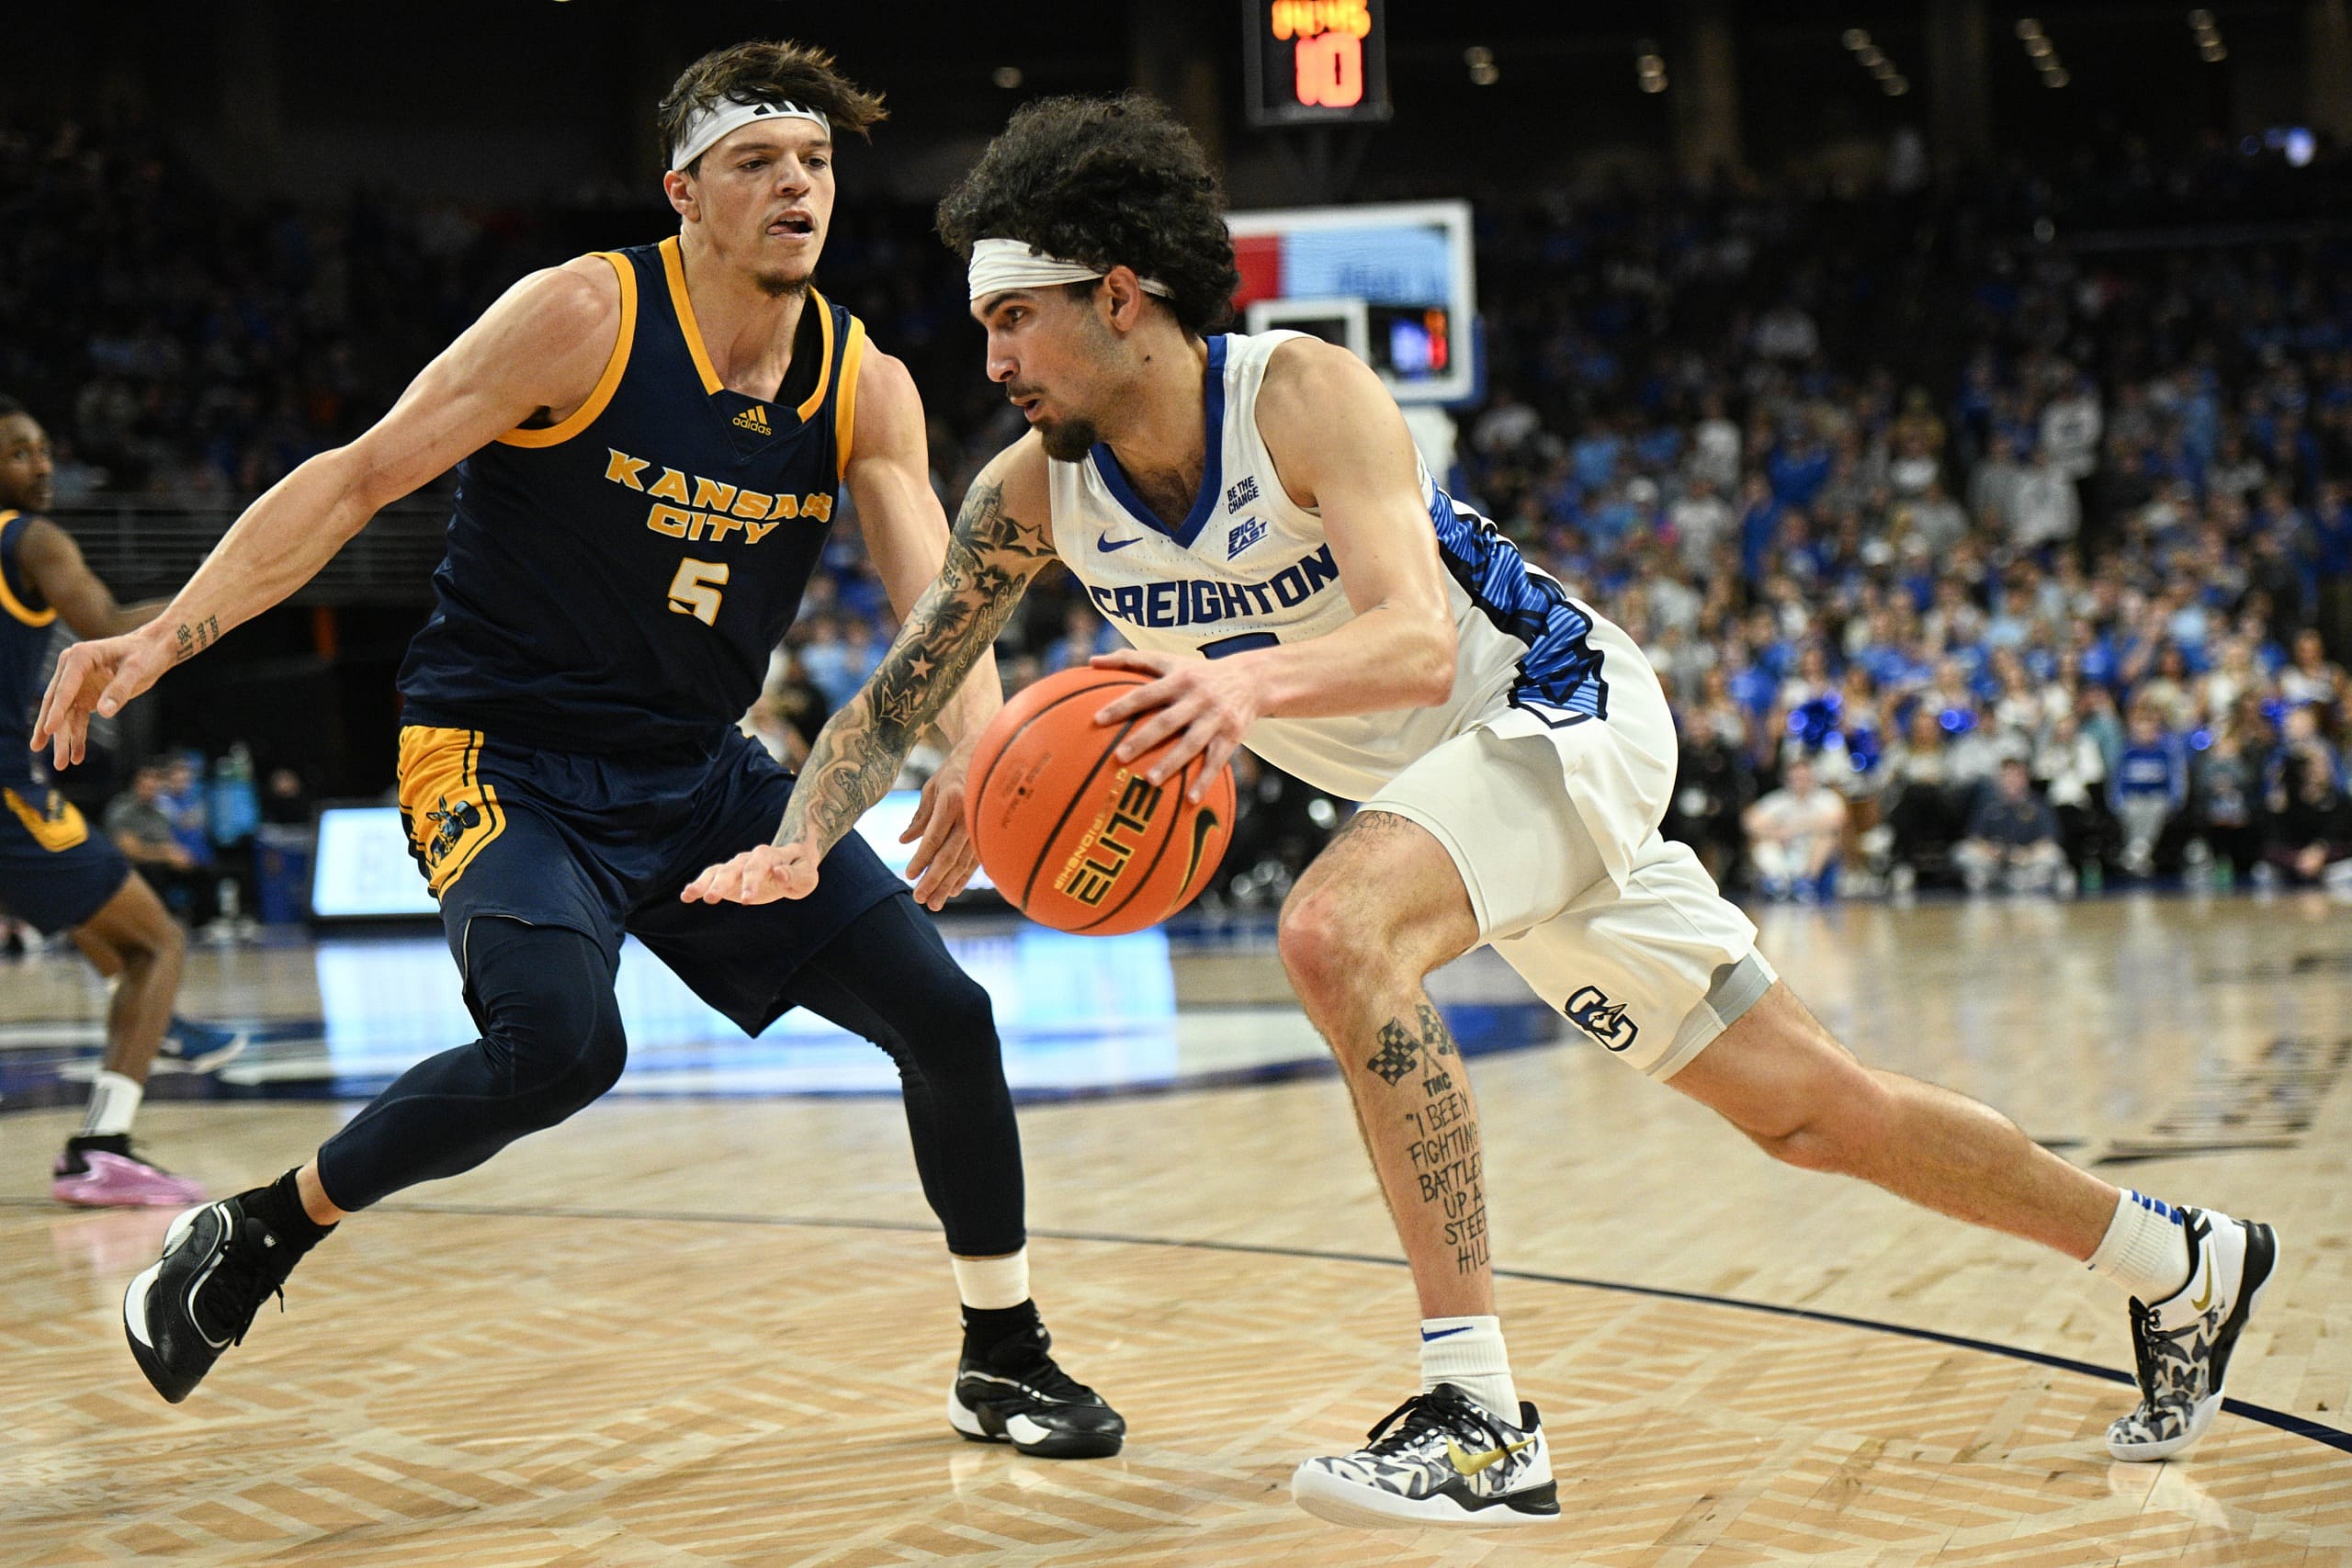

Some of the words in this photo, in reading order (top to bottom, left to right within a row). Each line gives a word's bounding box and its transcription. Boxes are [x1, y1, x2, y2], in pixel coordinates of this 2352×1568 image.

[1295, 33, 1363, 107] 10
[732, 417, 772, 436] adidas
[605, 447, 833, 523] KANSAS
[1227, 487, 1238, 502] BE
[1237, 476, 1254, 493] THE
[1227, 486, 1260, 514] CHANGE
[647, 502, 780, 545] CITY
[1228, 515, 1256, 544] BIG
[1228, 521, 1267, 555] EAST
[667, 557, 729, 626] 5
[1089, 542, 1340, 627] CREIGHTON
[1063, 774, 1163, 908] ELITE
[1423, 1072, 1452, 1098] TMC
[1426, 1088, 1470, 1132] BEEN
[1407, 1122, 1478, 1168] FIGHTING
[1418, 1152, 1483, 1203] BATTLE
[1443, 1191, 1467, 1220] UP
[1473, 1181, 1483, 1205] A
[1457, 1235, 1492, 1275] HILL
